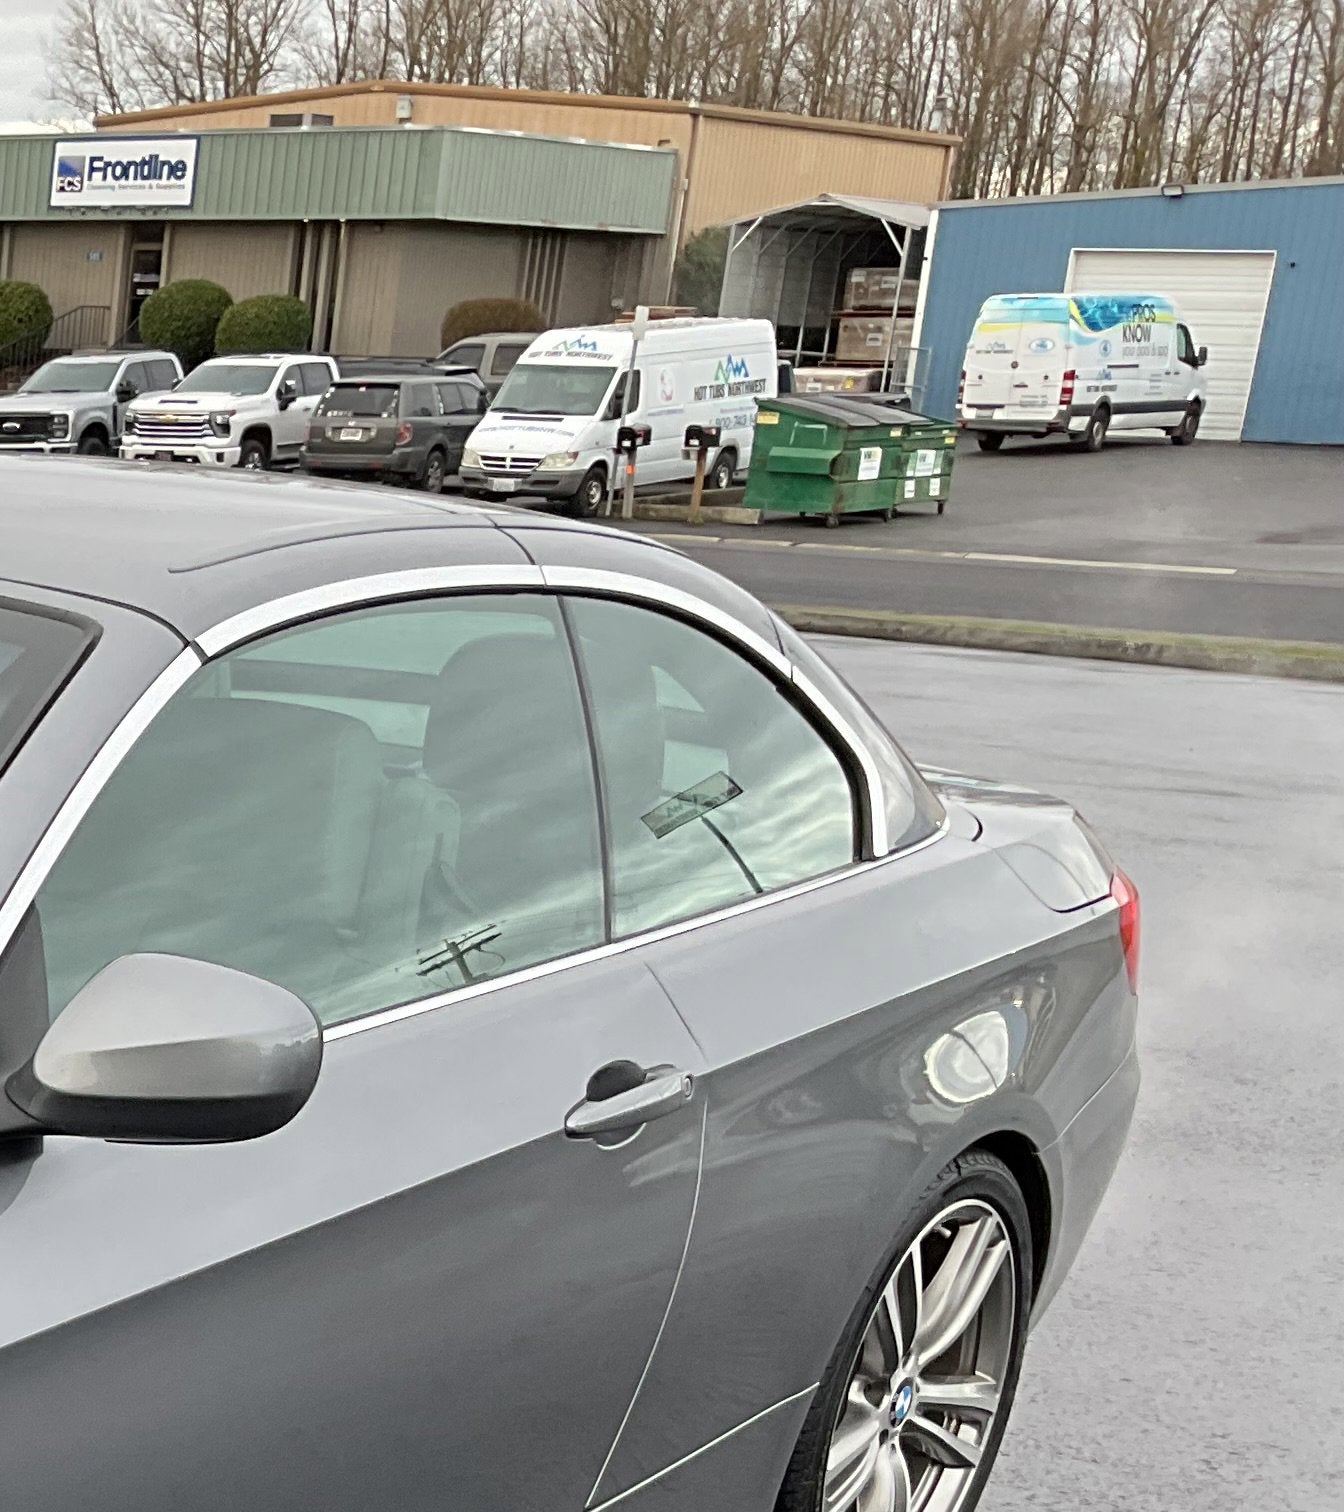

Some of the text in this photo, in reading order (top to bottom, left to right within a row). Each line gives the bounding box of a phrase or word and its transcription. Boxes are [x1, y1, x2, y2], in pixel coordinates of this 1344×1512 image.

[87, 153, 187, 181] Frontline
[56, 176, 81, 192] FCS
[1122, 323, 1151, 342] KNOW
